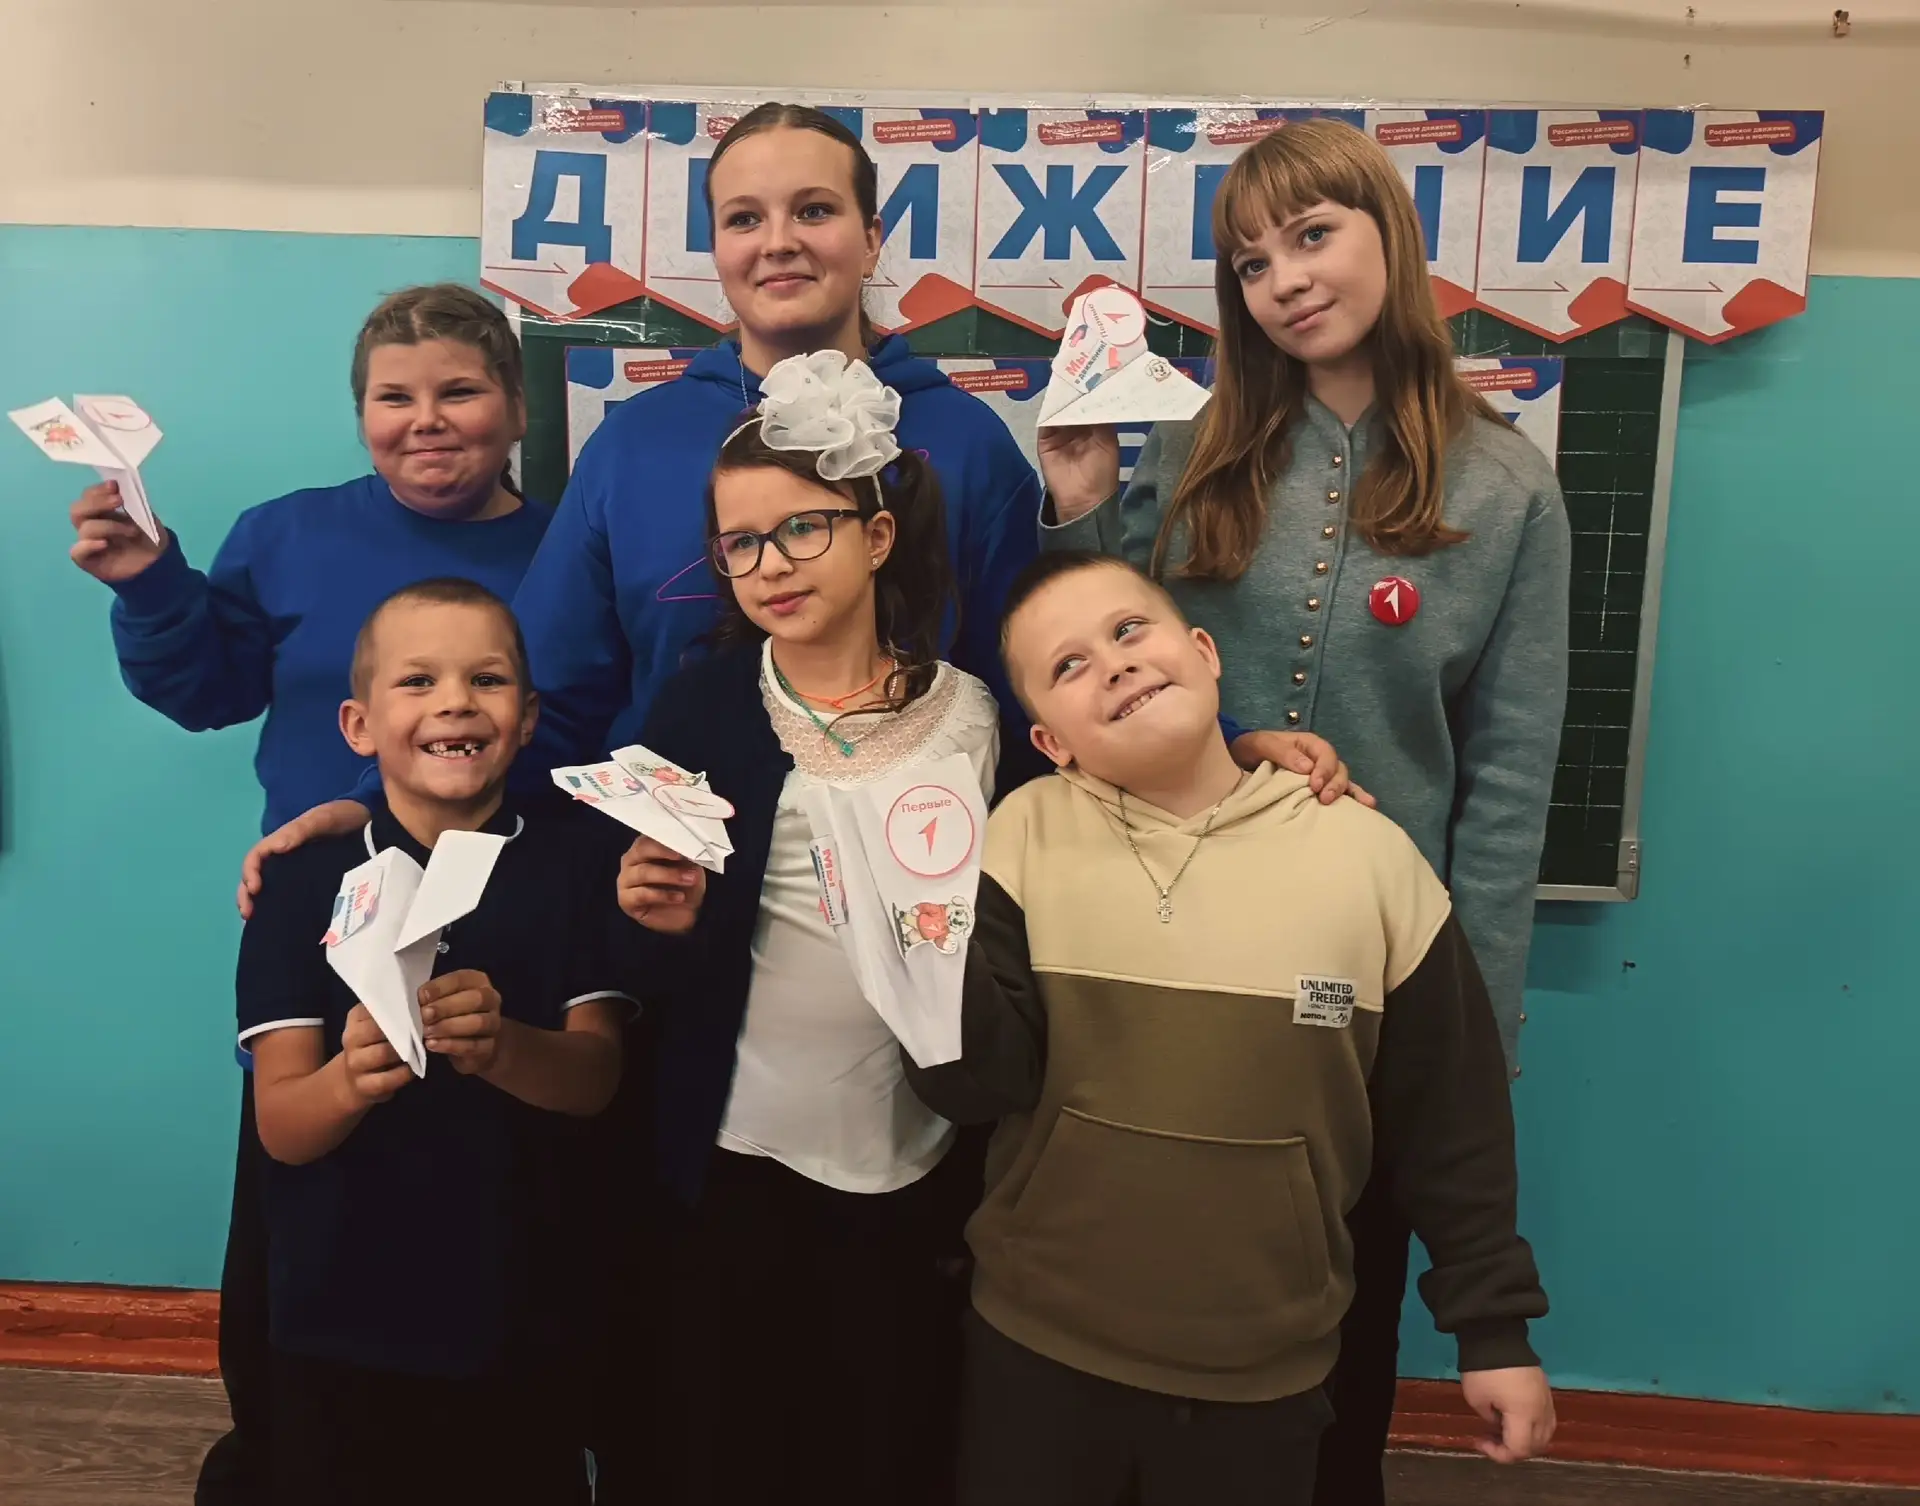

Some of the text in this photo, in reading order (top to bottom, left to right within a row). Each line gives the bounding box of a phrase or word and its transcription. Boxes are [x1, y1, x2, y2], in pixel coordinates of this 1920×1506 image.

[877, 123, 951, 133] Российское движение
[1421, 124, 1456, 132] движение
[1594, 125, 1629, 133] движение
[1064, 352, 1089, 376] Мы
[1496, 372, 1531, 380] движение
[594, 770, 613, 788] Мы
[901, 798, 952, 813] Первые
[354, 881, 369, 911] Мы
[1301, 979, 1353, 994] UNLIMITED
[1310, 991, 1354, 1005] FREEDOM
